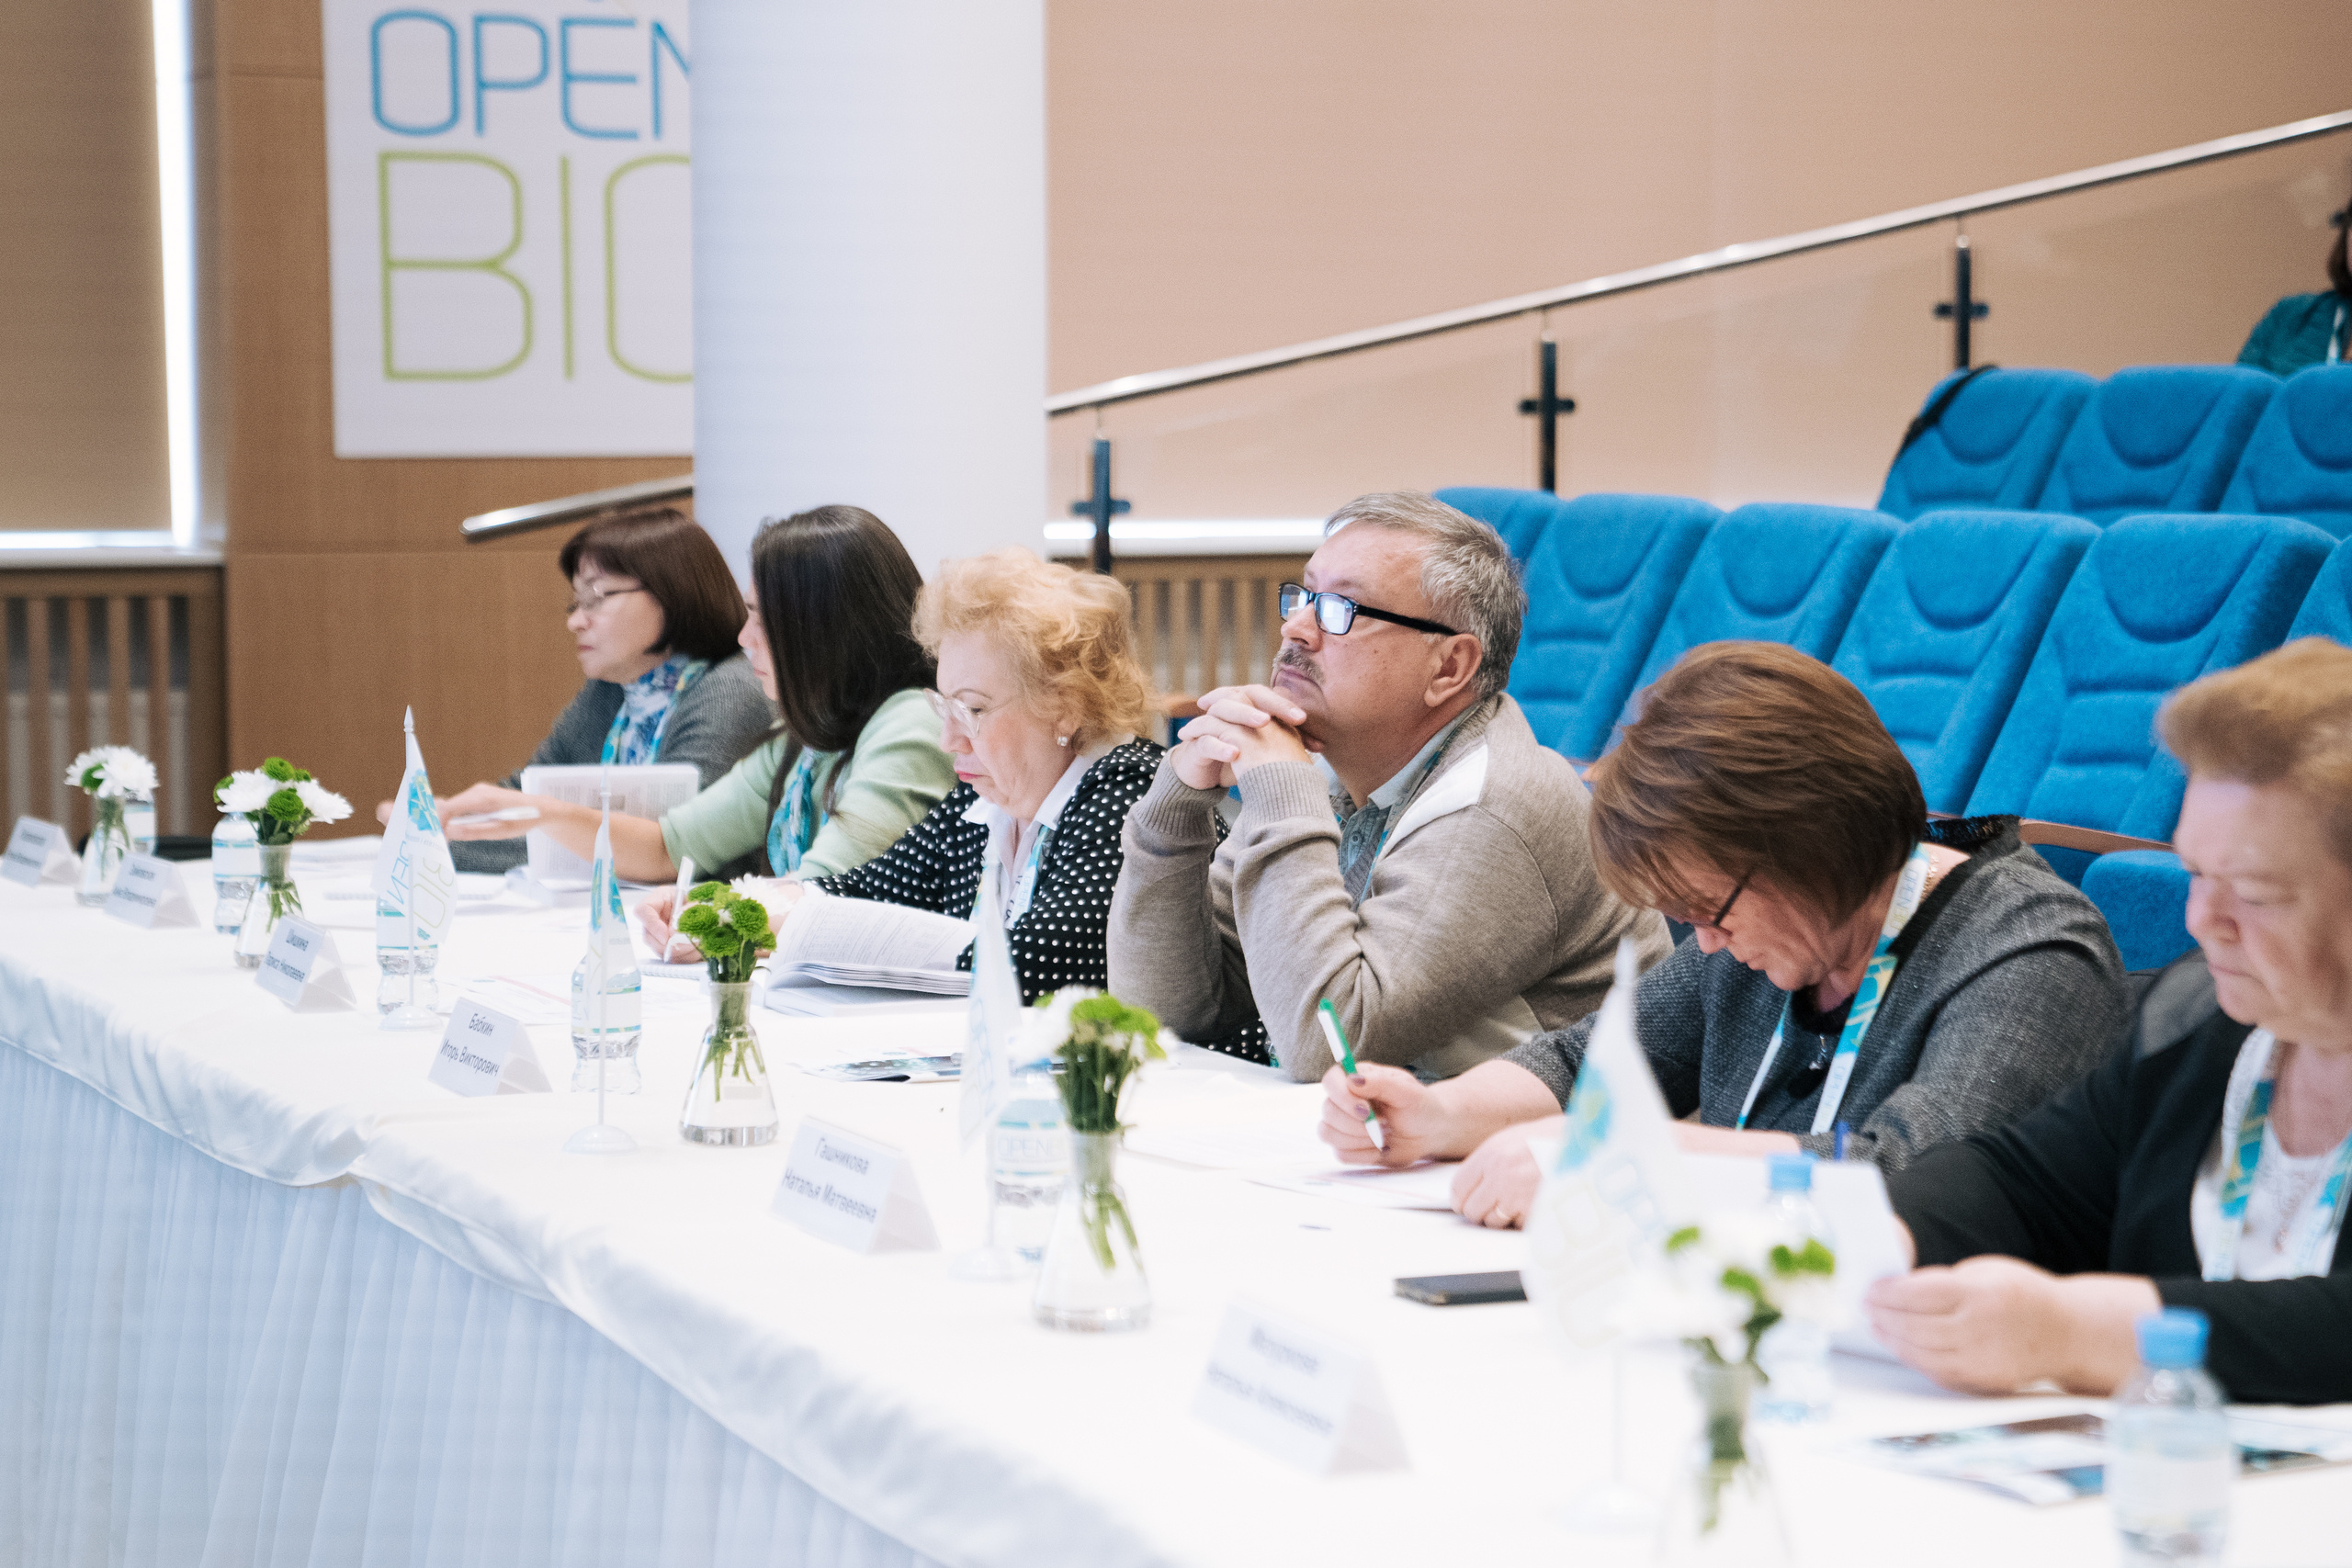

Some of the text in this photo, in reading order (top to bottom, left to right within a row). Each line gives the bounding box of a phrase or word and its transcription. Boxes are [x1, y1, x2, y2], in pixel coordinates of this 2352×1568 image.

[469, 1013, 494, 1036] Бабкин
[440, 1038, 500, 1077] Игорь Викторович
[782, 1168, 821, 1201] Наталья
